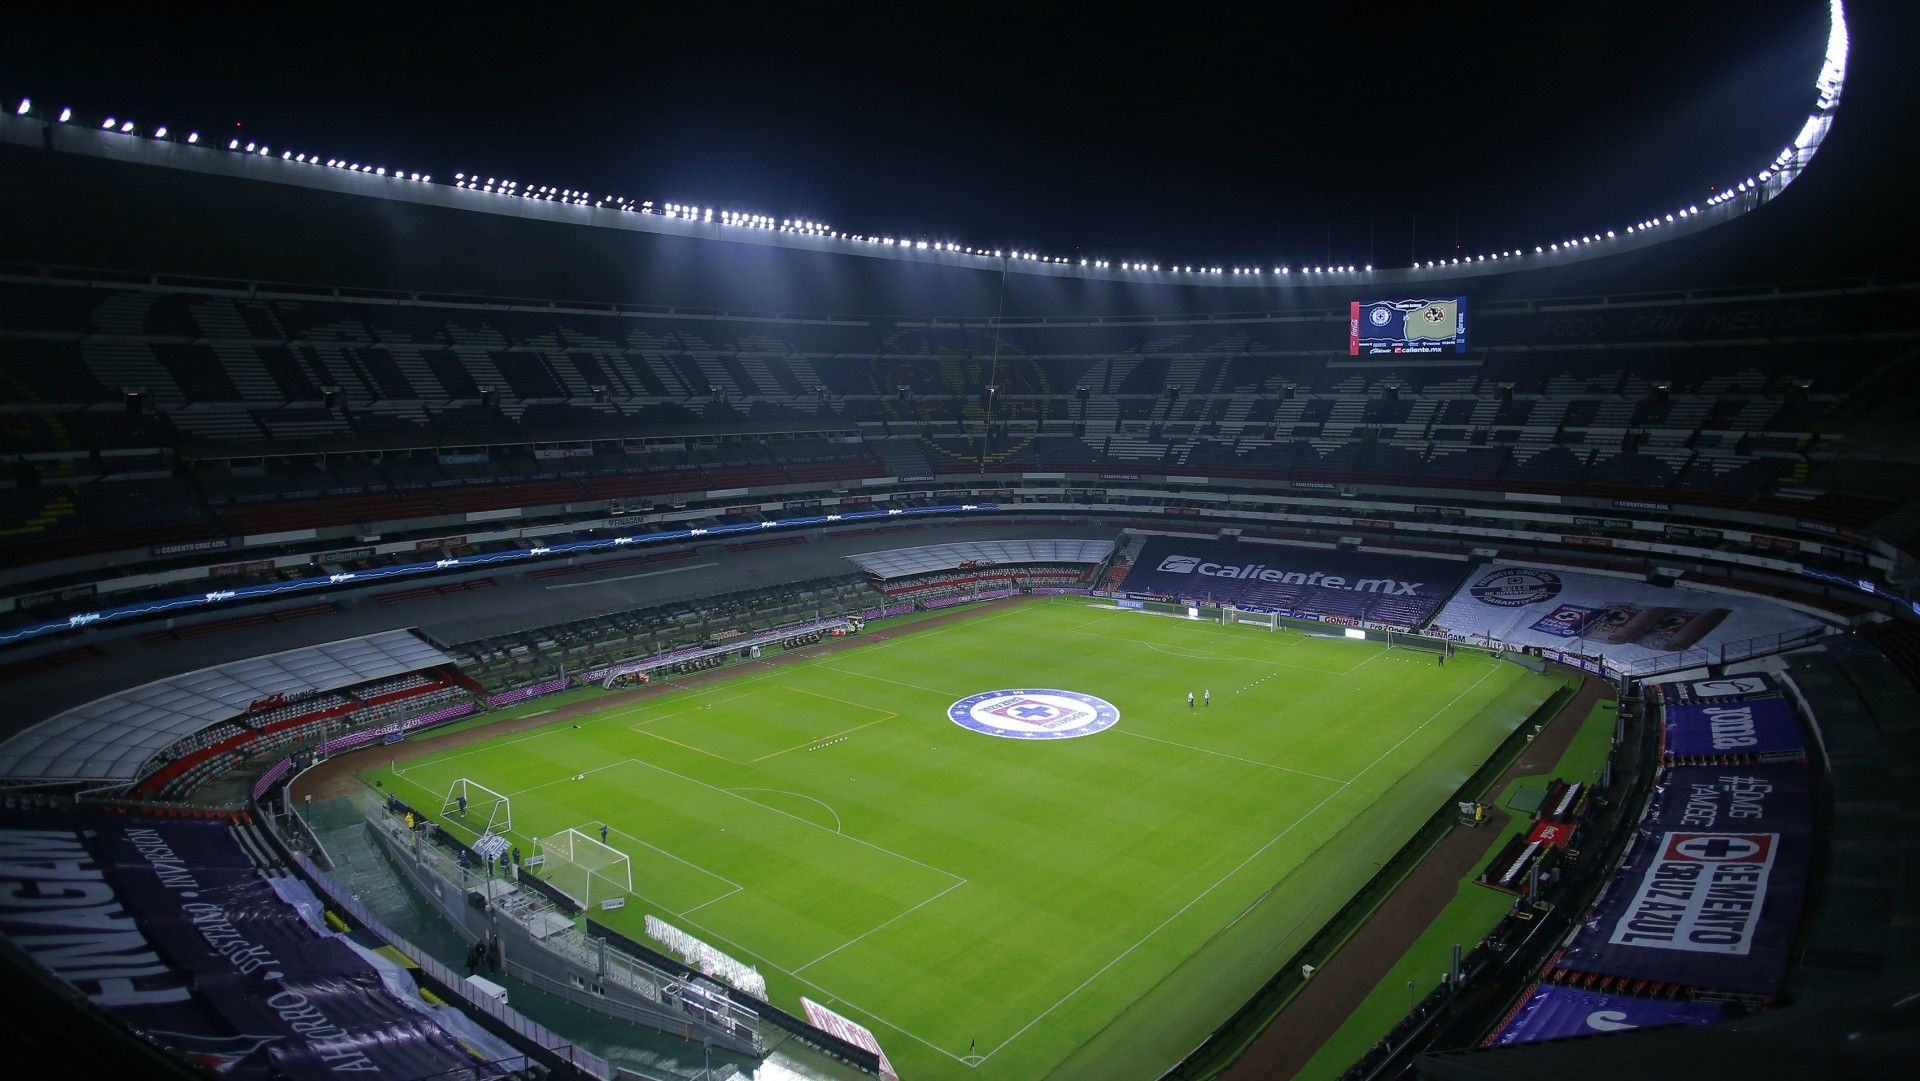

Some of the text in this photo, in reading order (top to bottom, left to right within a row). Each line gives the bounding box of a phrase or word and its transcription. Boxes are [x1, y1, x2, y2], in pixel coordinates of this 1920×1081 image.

[1402, 346, 1443, 354] caliente.mx
[162, 544, 194, 554] CEMENTO
[1197, 560, 1425, 597] caliente.mx
[1324, 616, 1360, 628] GONHER
[1430, 631, 1466, 642] FINAGAM
[284, 688, 320, 703] LOUNGE
[375, 724, 398, 736] CRUZ
[1647, 862, 1705, 900] CRUZ
[1689, 864, 1763, 945] CEMENTO
[1621, 900, 1686, 944] AZUL
[267, 990, 382, 1073] AHORRO
